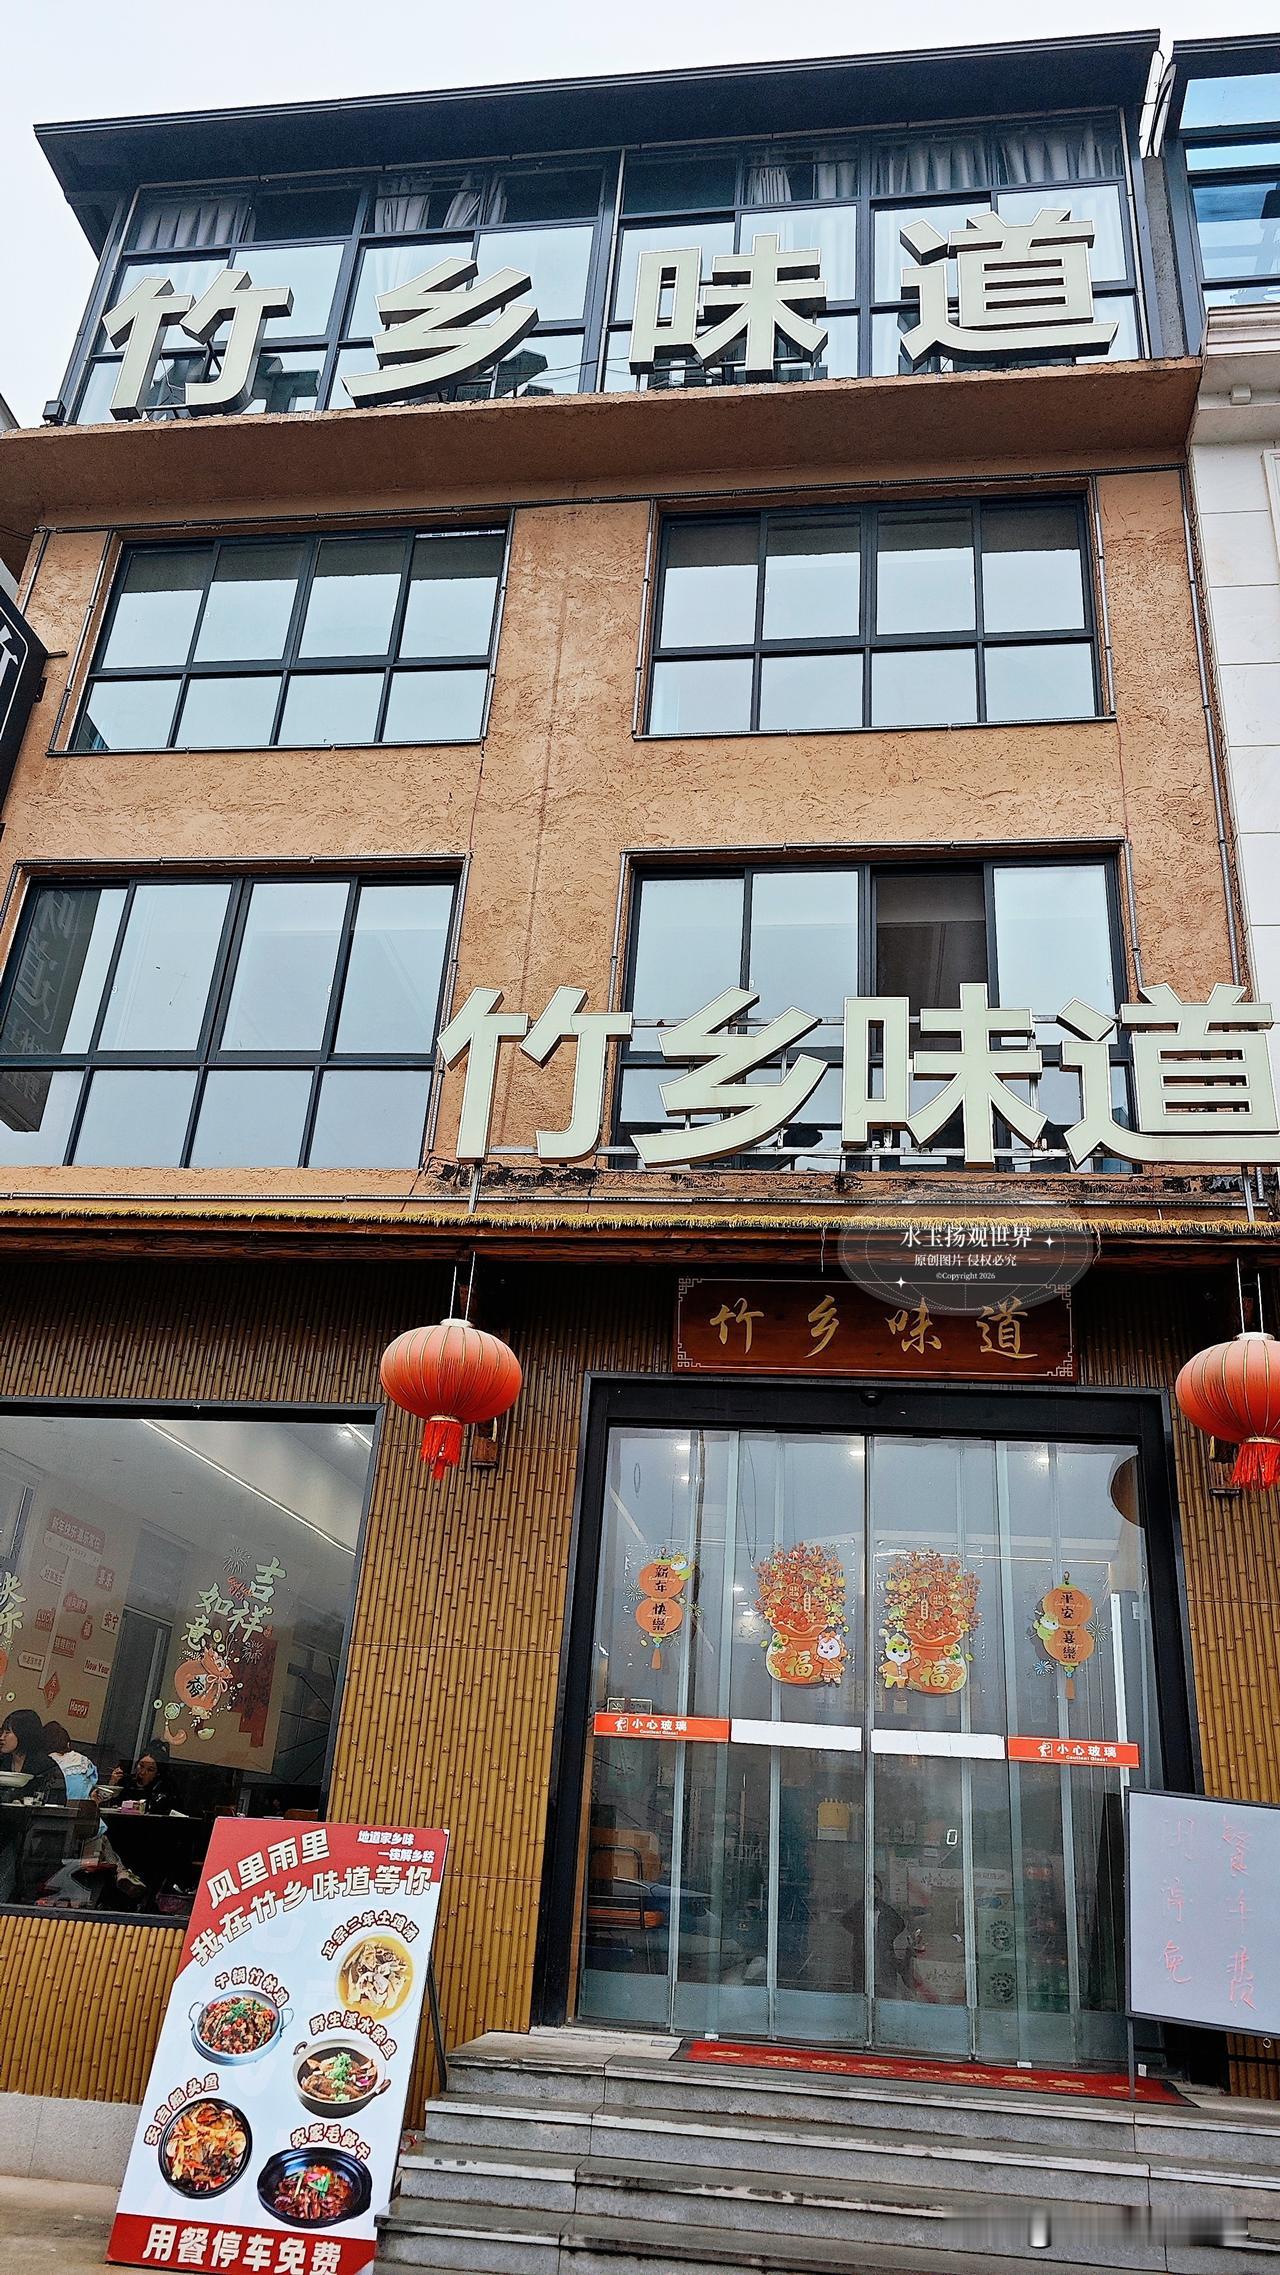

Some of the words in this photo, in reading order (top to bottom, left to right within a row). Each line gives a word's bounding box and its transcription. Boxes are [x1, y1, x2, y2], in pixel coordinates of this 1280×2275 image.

[102, 208, 1119, 419] 竹乡味道
[437, 983, 1280, 1168] 竹乡味道
[709, 1295, 1037, 1359] 竹乡味道
[785, 1649, 813, 1678] 福
[921, 1660, 950, 1688] 福
[632, 1719, 687, 1731] 小心玻璃
[1057, 1744, 1117, 1758] 小心玻璃
[357, 1830, 415, 1846] 地道家乡味
[206, 1828, 330, 1910] 风里雨里
[190, 1864, 433, 1967] 我在竹乡味道等你
[142, 2223, 342, 2275] 用餐停车免费
